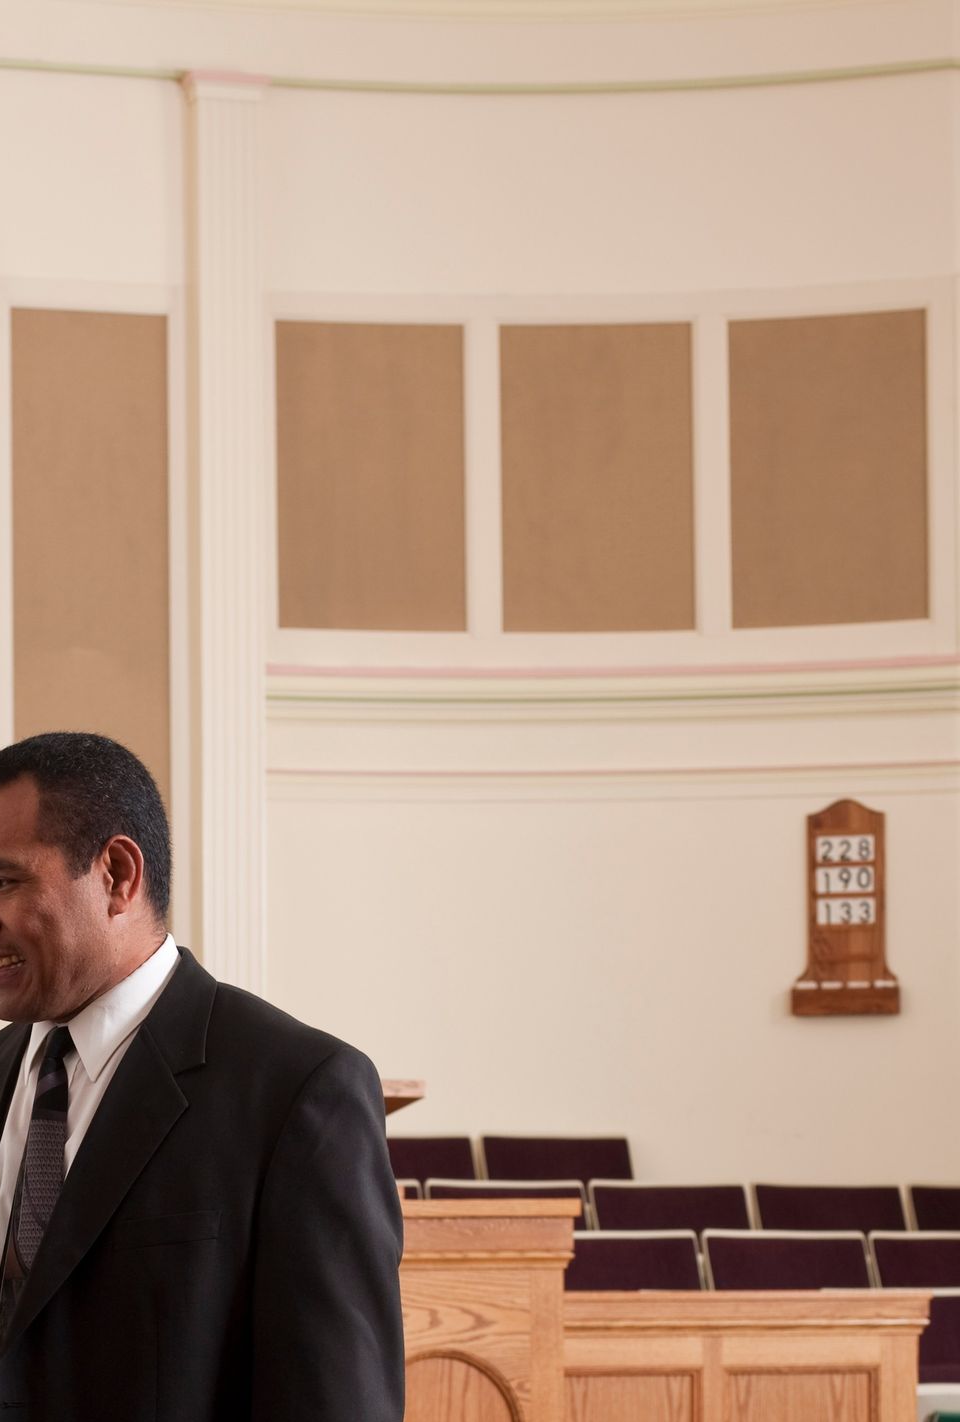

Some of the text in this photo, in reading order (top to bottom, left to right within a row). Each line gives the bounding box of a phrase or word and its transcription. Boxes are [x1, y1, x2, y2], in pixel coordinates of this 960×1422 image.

[821, 838, 871, 861] 228
[823, 867, 871, 893] 190
[824, 901, 871, 924] 133
